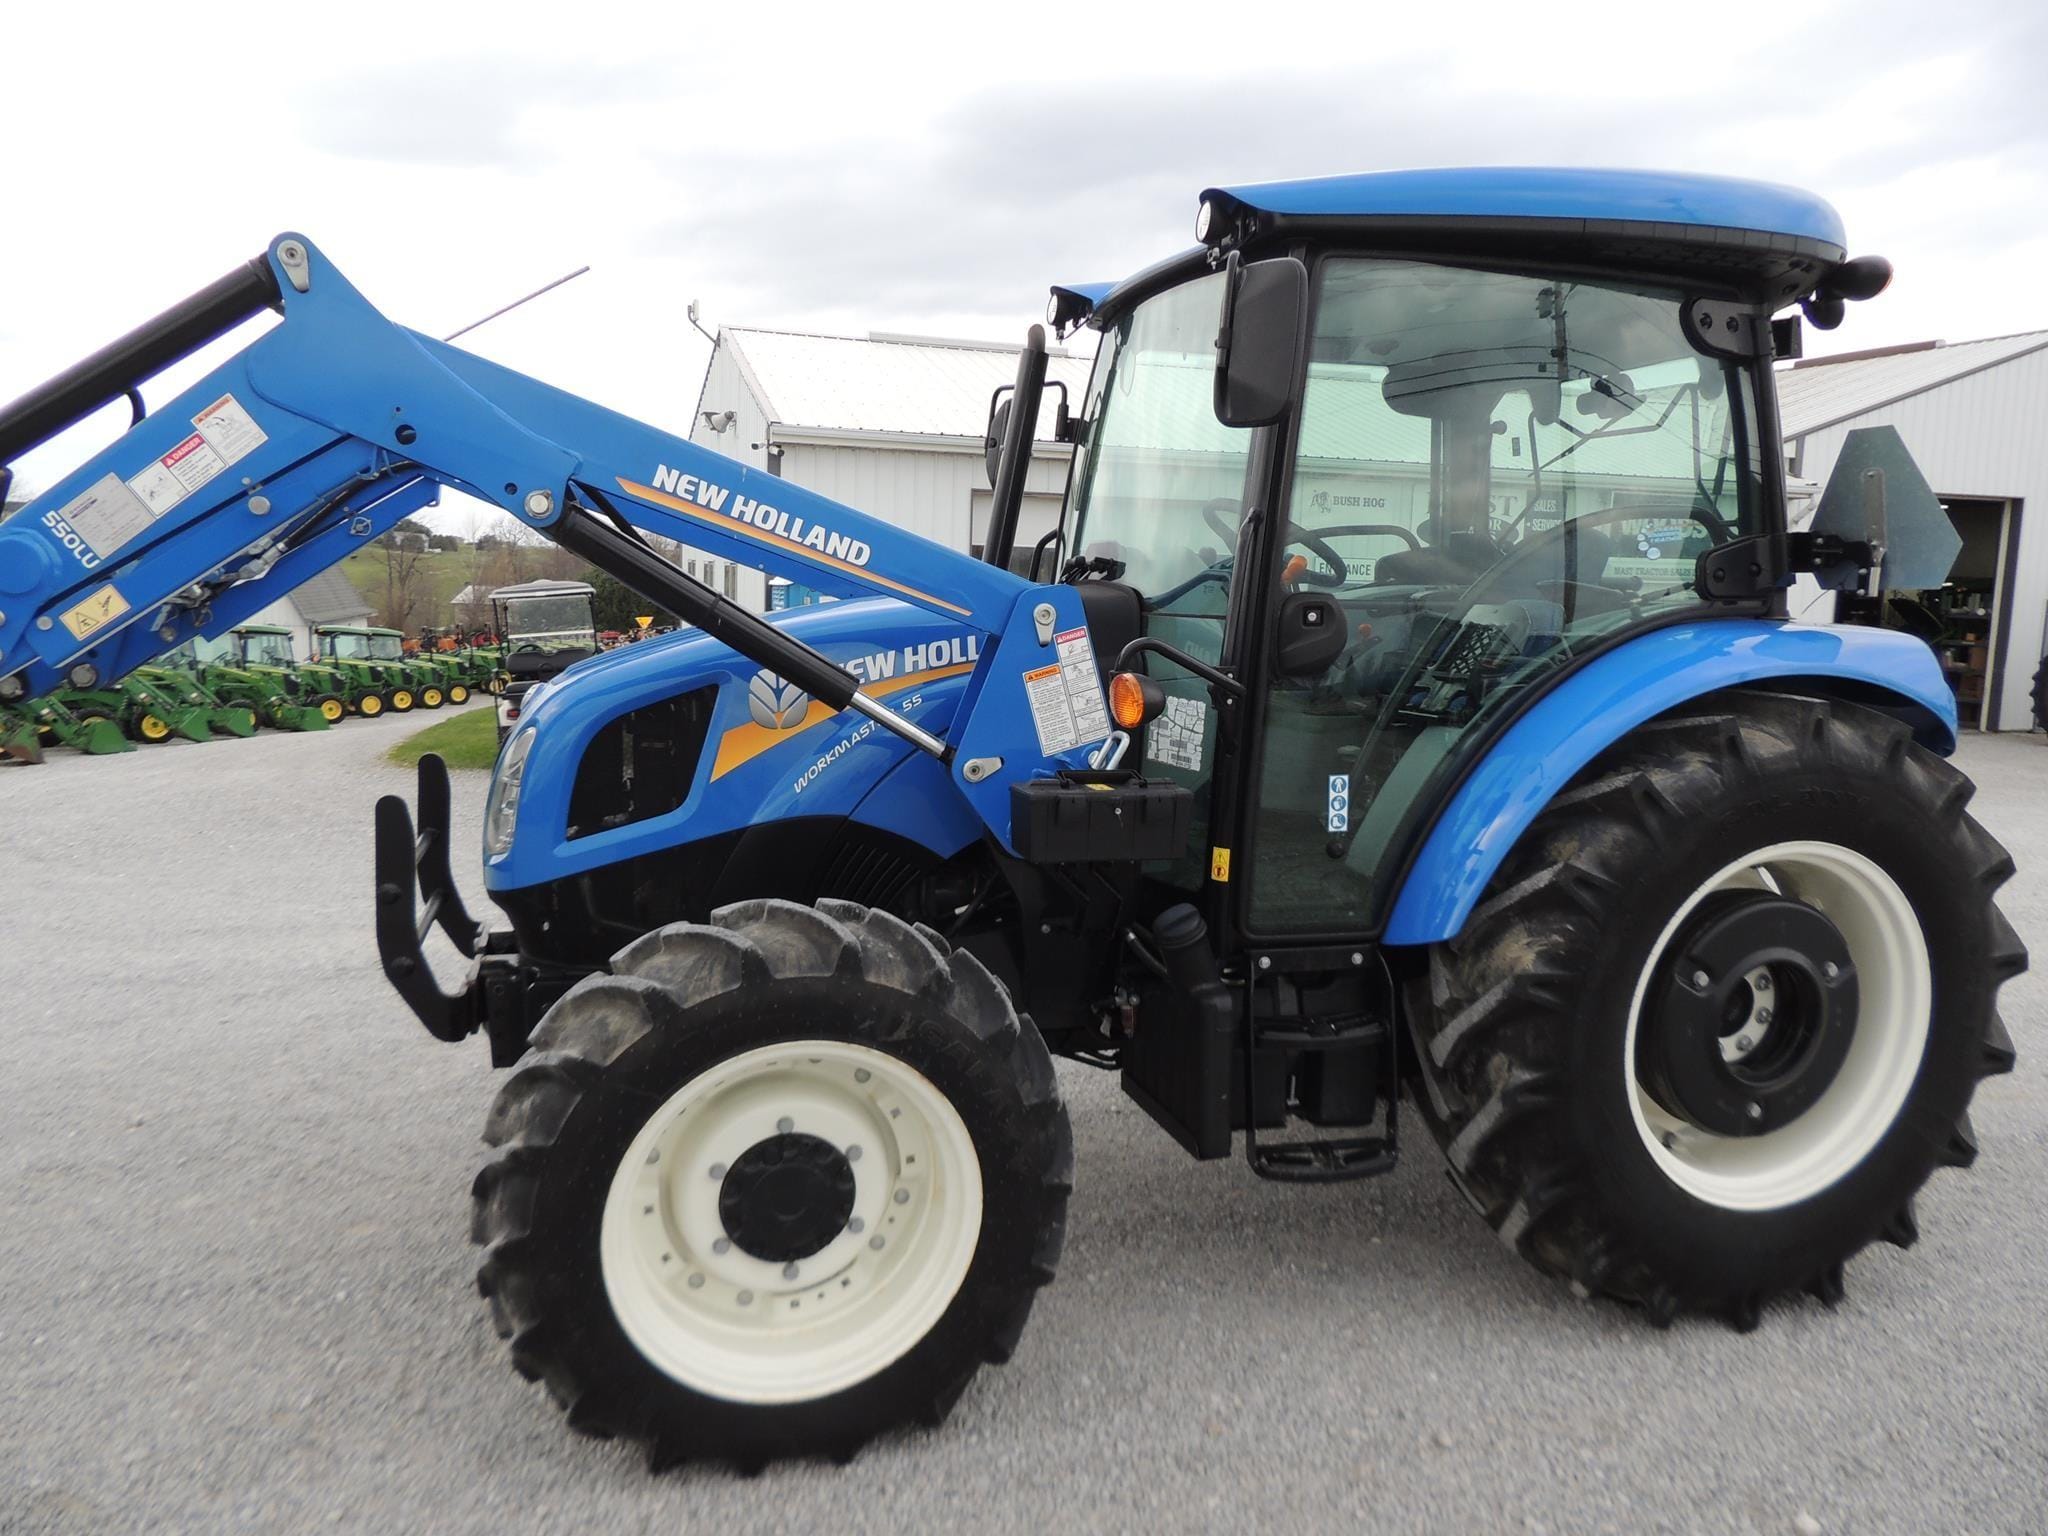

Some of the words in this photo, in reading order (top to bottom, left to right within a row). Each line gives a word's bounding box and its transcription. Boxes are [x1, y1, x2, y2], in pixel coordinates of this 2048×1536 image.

[172, 437, 202, 461] DANGER
[1333, 495, 1360, 506] BUSH
[1363, 497, 1385, 508] HOG
[1534, 499, 1557, 513] SALES
[652, 463, 729, 511] NEW
[730, 495, 871, 567] HOLLAND
[41, 510, 100, 569] 550LU
[1319, 562, 1371, 576] ENANCE
[1062, 630, 1086, 641] DANGER
[839, 650, 896, 684] EW
[794, 709, 894, 794] WORKMAST
[902, 694, 923, 712] 55
